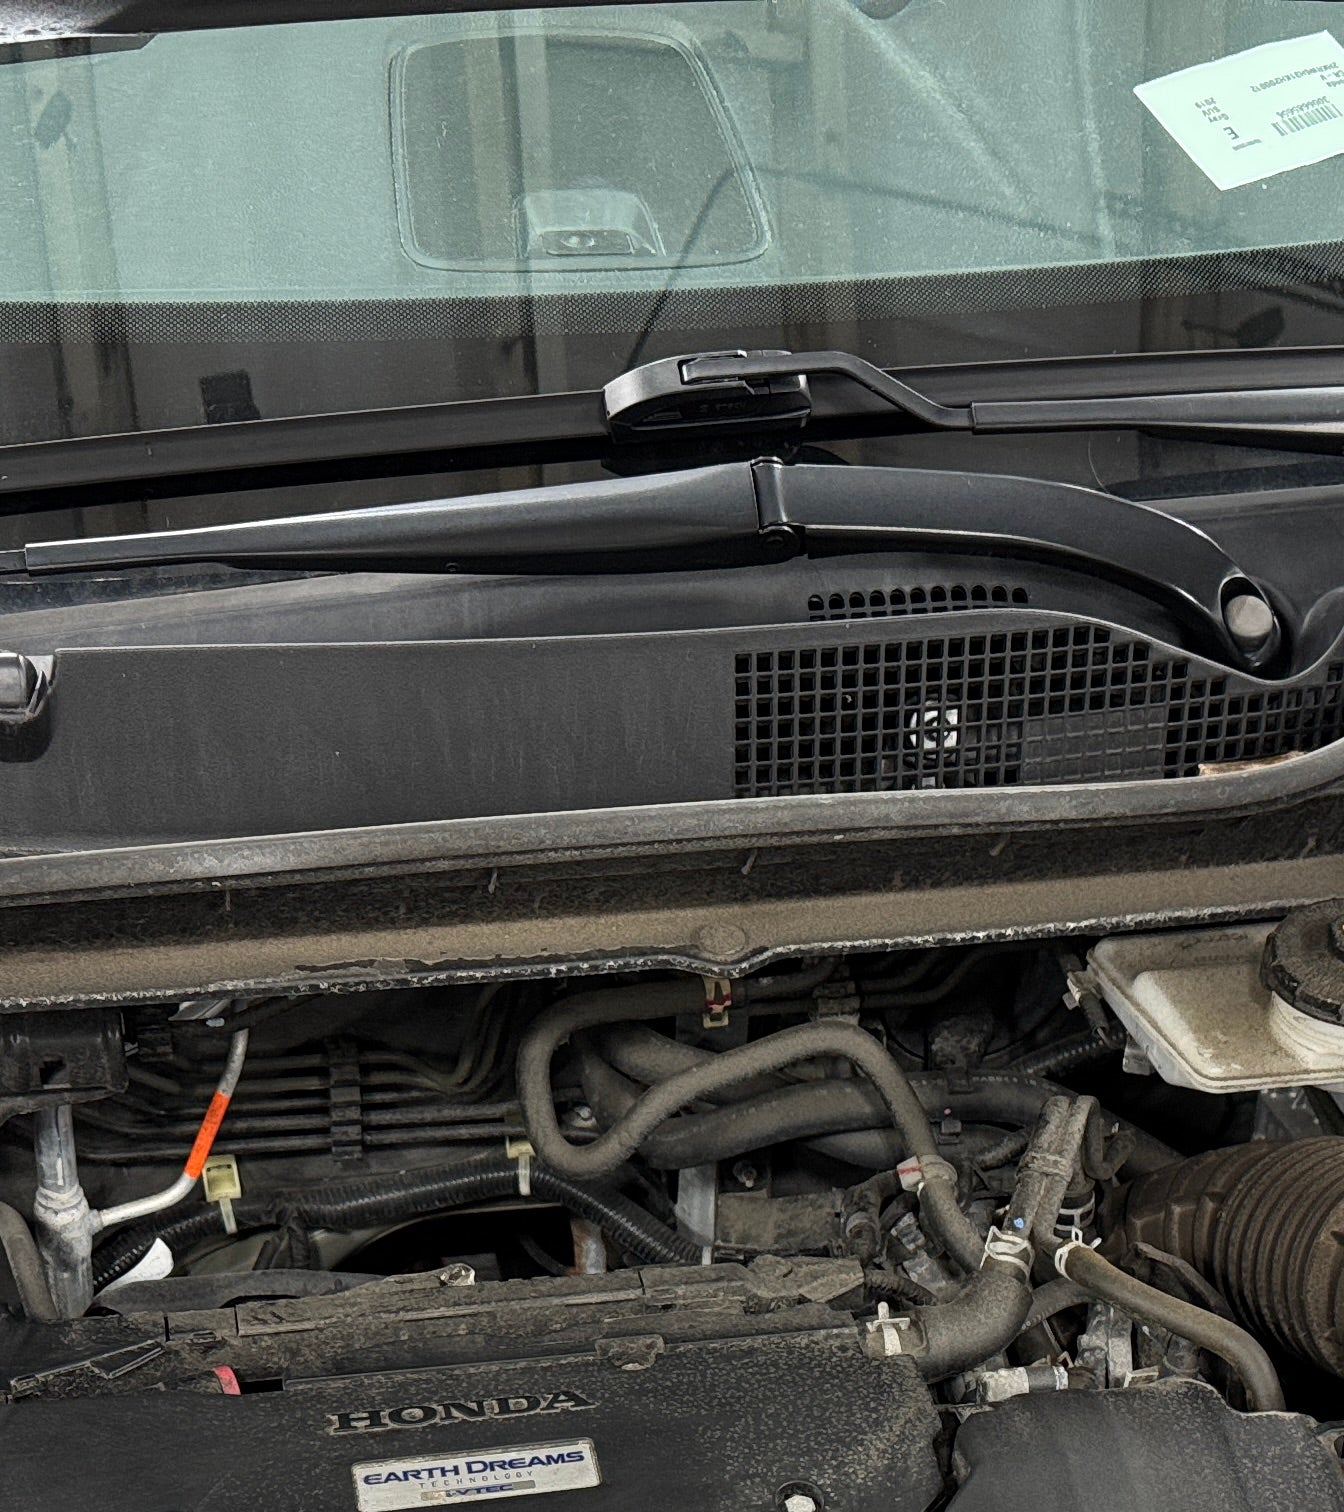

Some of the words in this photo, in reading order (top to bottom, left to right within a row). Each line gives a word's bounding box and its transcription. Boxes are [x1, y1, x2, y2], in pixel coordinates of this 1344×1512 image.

[330, 1390, 599, 1435] HONDA
[363, 1465, 460, 1485] EARTH
[465, 1451, 585, 1474] DREAMS
[420, 1470, 534, 1489] TECHNOLOGY
